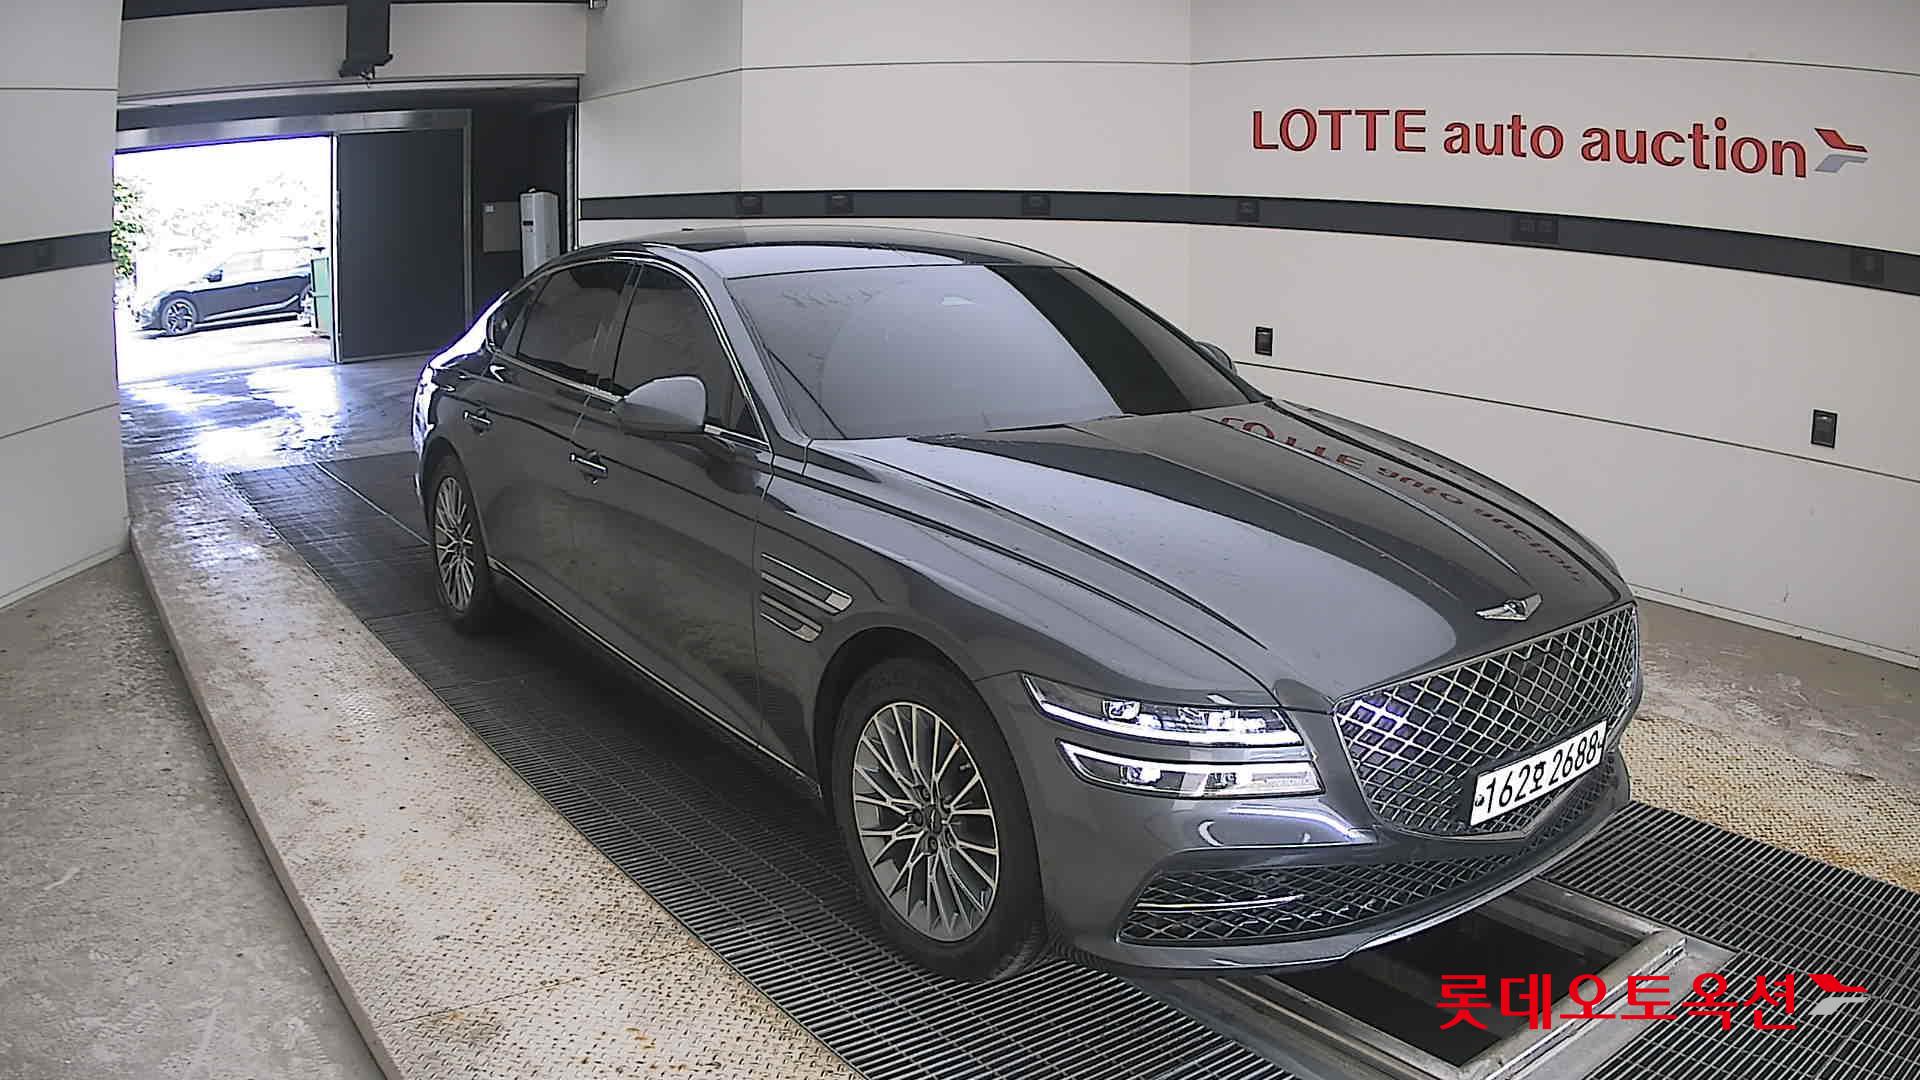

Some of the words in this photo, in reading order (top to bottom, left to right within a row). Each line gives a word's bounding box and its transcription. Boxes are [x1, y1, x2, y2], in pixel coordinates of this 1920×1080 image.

[1251, 109, 1426, 152] LOTTE
[1443, 114, 1565, 158] auto
[1581, 117, 1808, 178] auction
[1486, 761, 1546, 813] 162호
[1548, 730, 1599, 786] 2688
